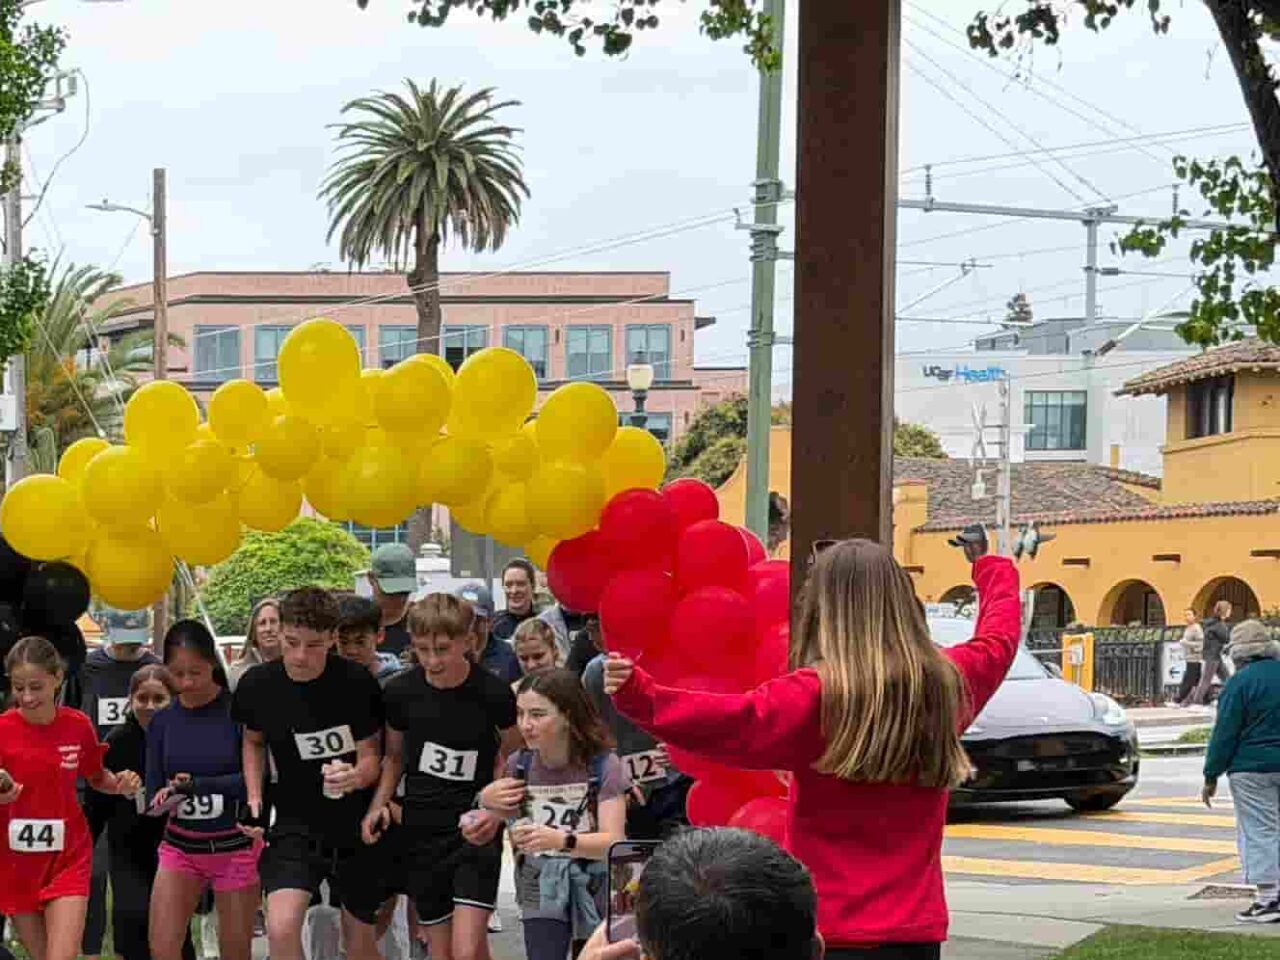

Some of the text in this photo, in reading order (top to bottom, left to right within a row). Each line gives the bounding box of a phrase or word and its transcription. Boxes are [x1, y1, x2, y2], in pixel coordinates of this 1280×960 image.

[304, 731, 343, 755] 30
[429, 749, 466, 778] 31
[628, 755, 656, 780] 12
[183, 794, 213, 816] 39
[542, 805, 578, 829] 24
[17, 824, 55, 848] 44
